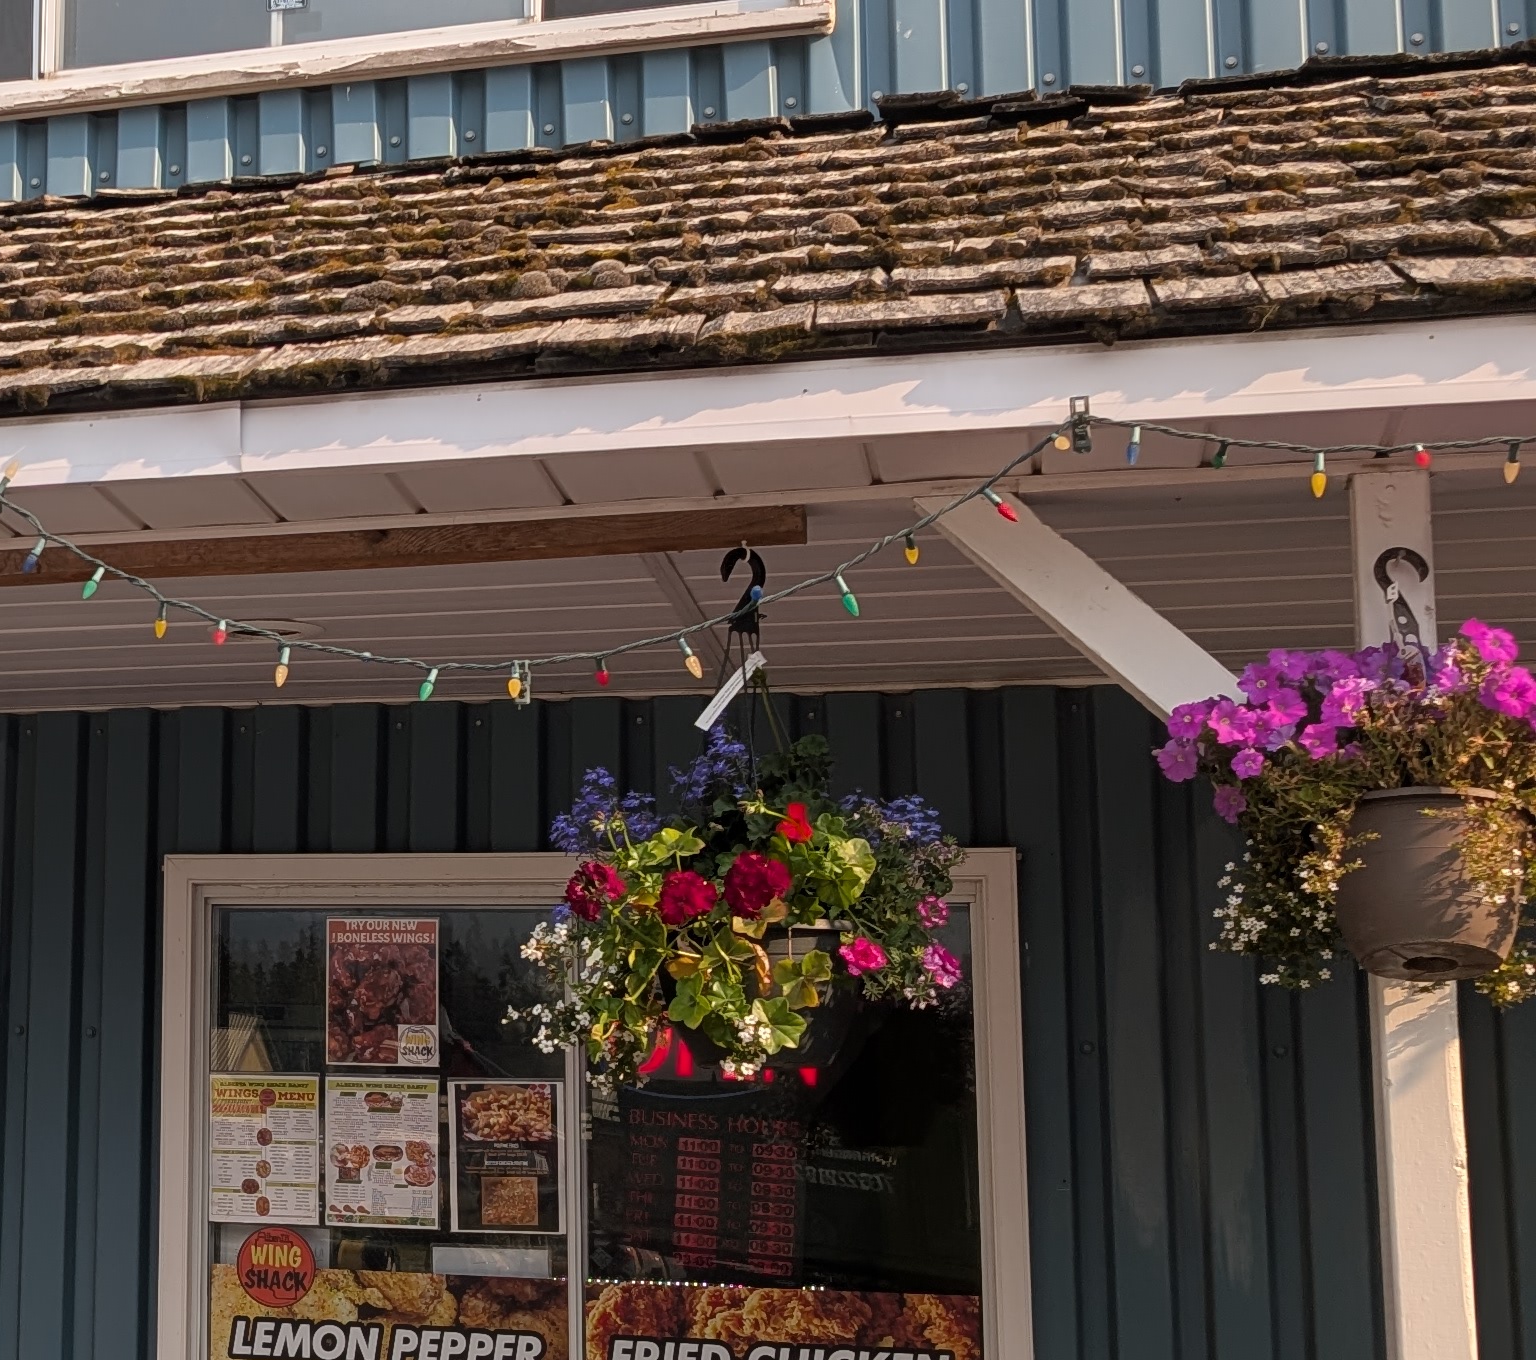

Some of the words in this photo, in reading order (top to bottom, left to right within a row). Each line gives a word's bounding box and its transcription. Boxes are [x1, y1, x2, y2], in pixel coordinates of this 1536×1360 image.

[344, 920, 364, 931] TRY
[366, 920, 390, 931] OUR
[392, 920, 418, 931] NEW
[401, 1045, 433, 1056] SHACK
[214, 1088, 260, 1099] WINGS
[277, 1091, 316, 1102] MENU
[629, 1109, 719, 1130] BUSINESS
[250, 1243, 302, 1268] WING
[244, 1268, 308, 1292] SHACK
